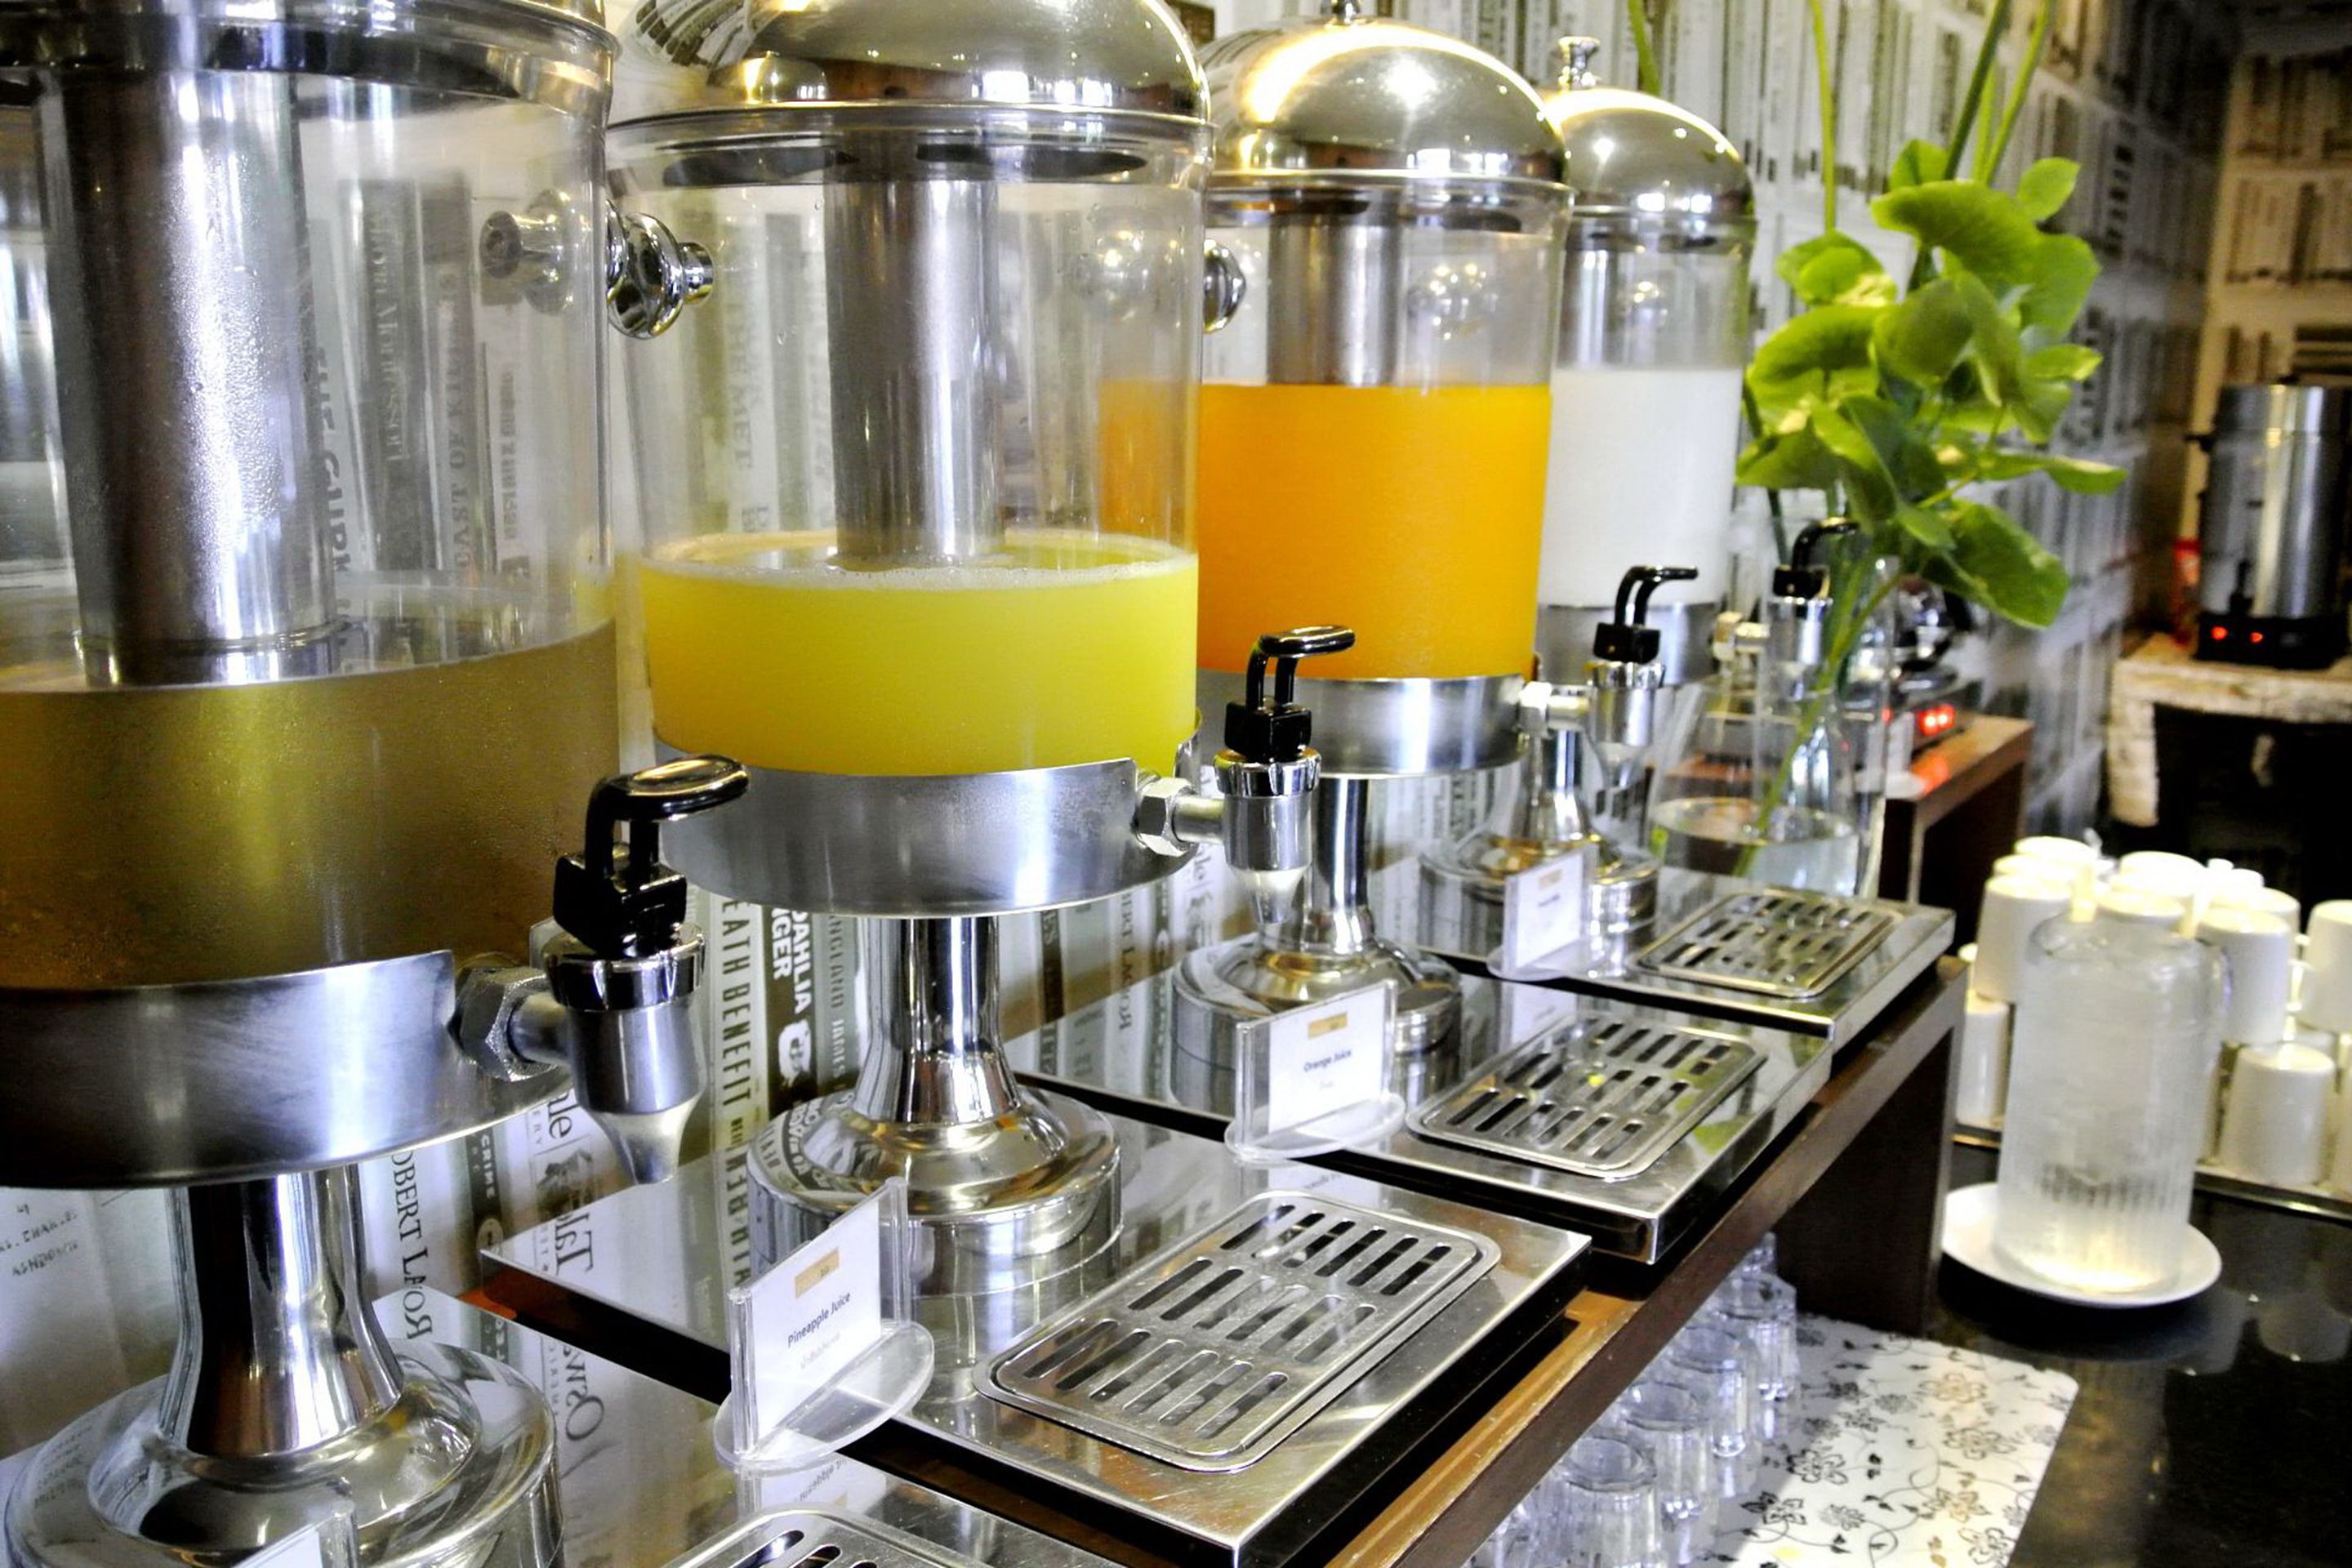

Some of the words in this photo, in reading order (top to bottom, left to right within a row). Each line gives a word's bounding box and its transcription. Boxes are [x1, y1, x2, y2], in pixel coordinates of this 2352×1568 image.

[828, 913, 845, 1009] NGLAND
[722, 982, 752, 1107] BENEFIT
[481, 1134, 497, 1199] CRIME
[787, 1307, 830, 1348] Pineapple
[831, 1291, 851, 1316] Juice
